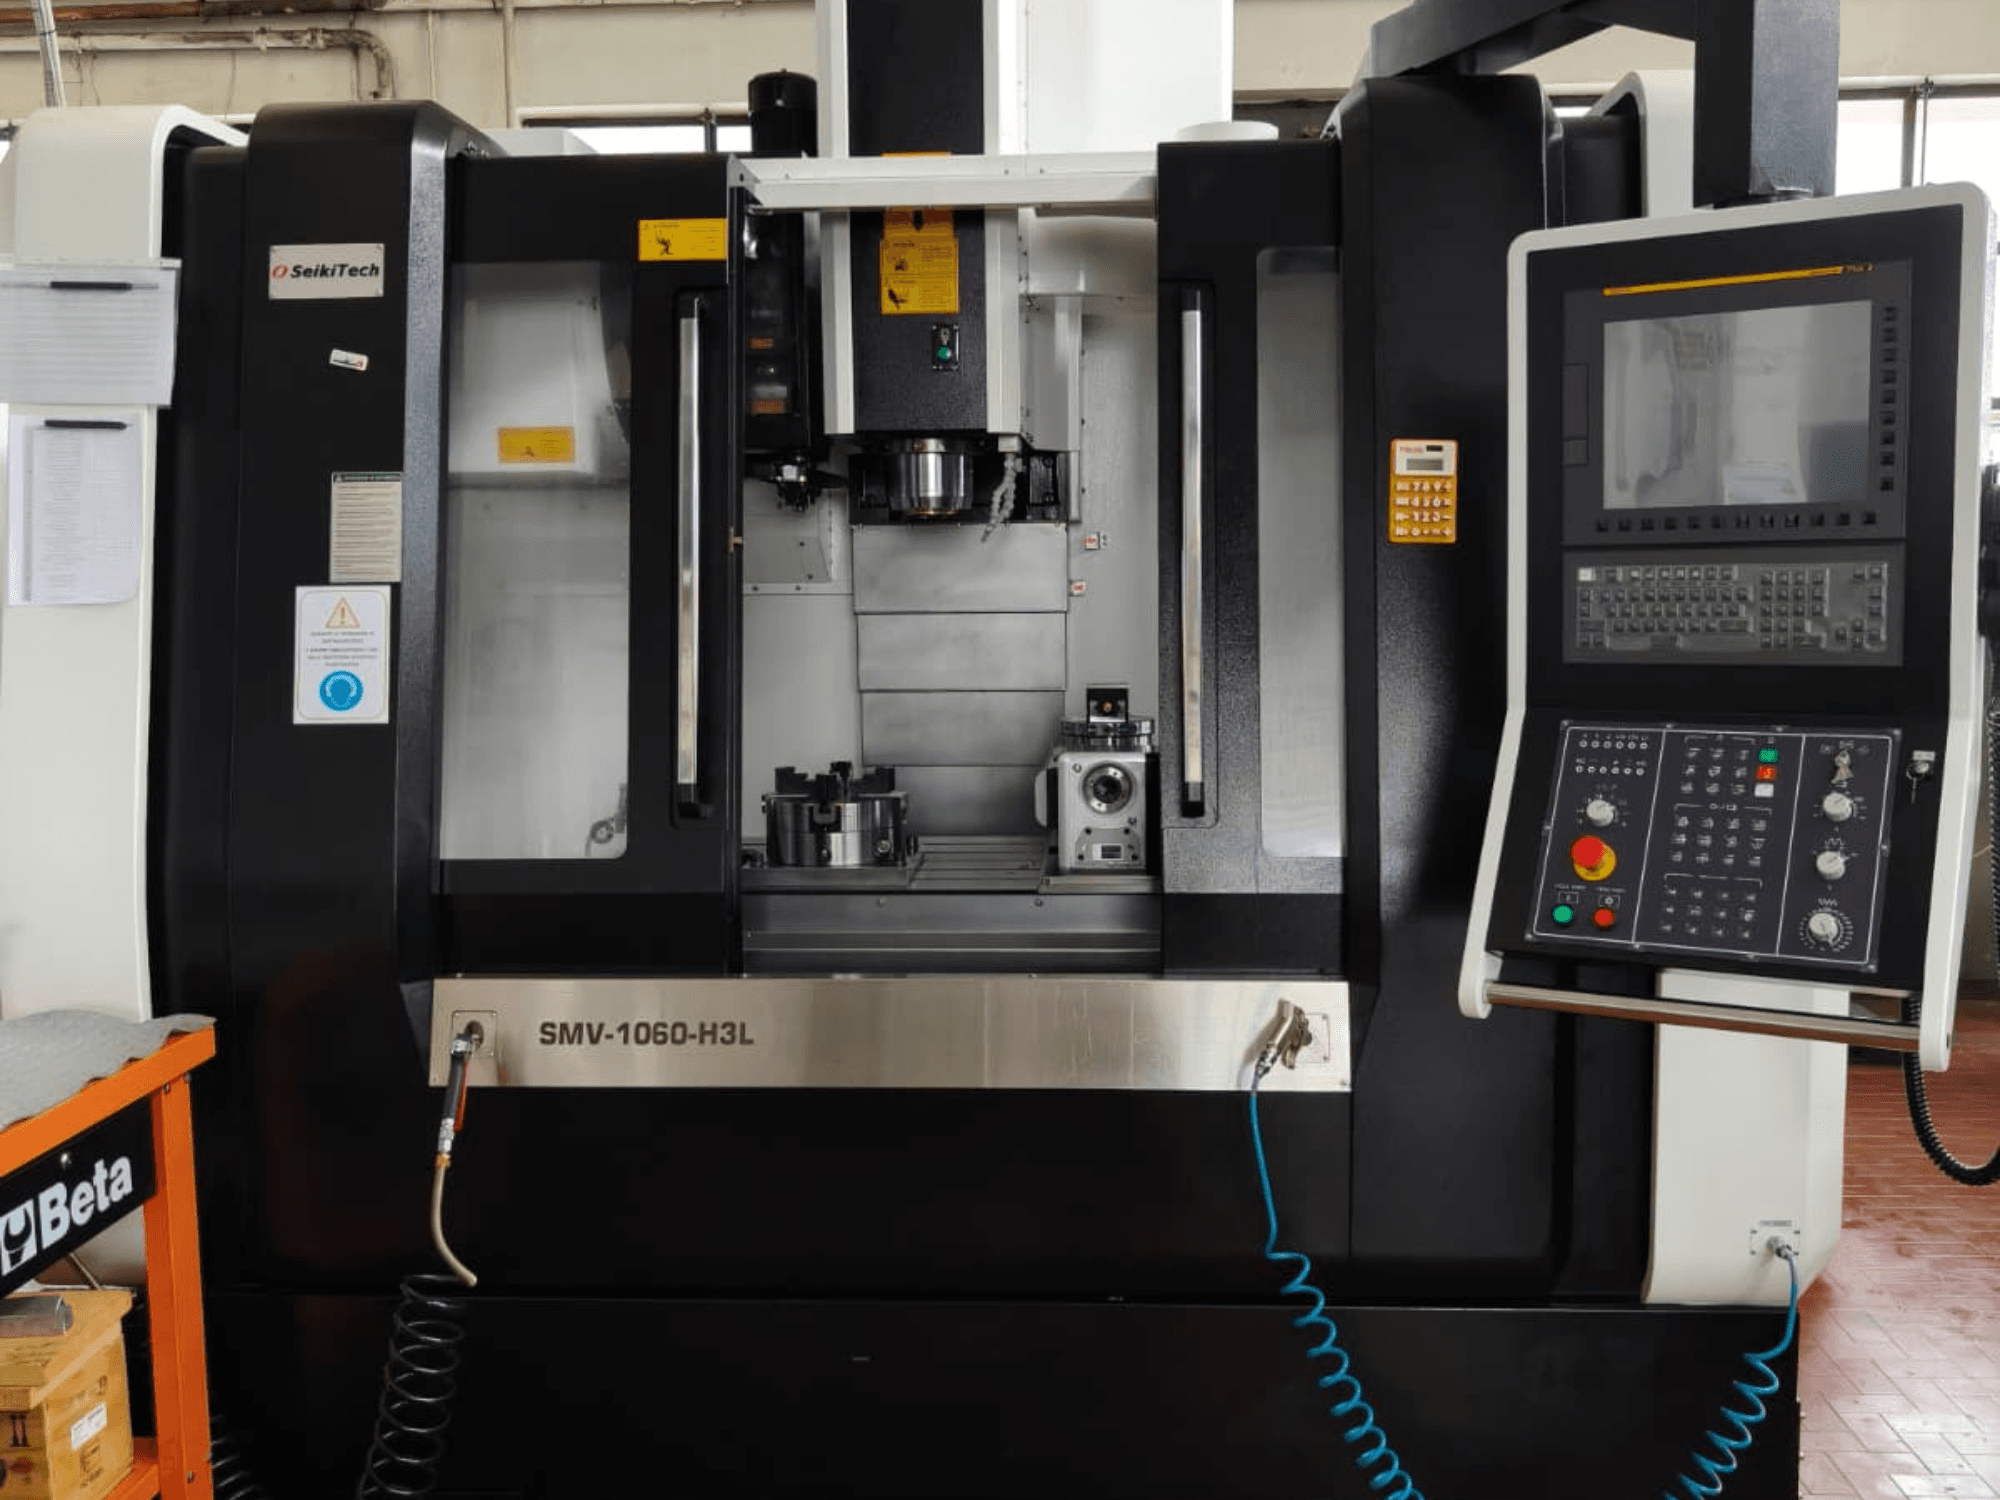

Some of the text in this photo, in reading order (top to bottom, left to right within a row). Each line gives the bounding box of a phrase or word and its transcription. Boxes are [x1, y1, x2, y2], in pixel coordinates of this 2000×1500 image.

[291, 263, 379, 279] SeikiTech
[539, 1021, 755, 1046] SMV-1060-H3L
[39, 1155, 133, 1250] Beta
